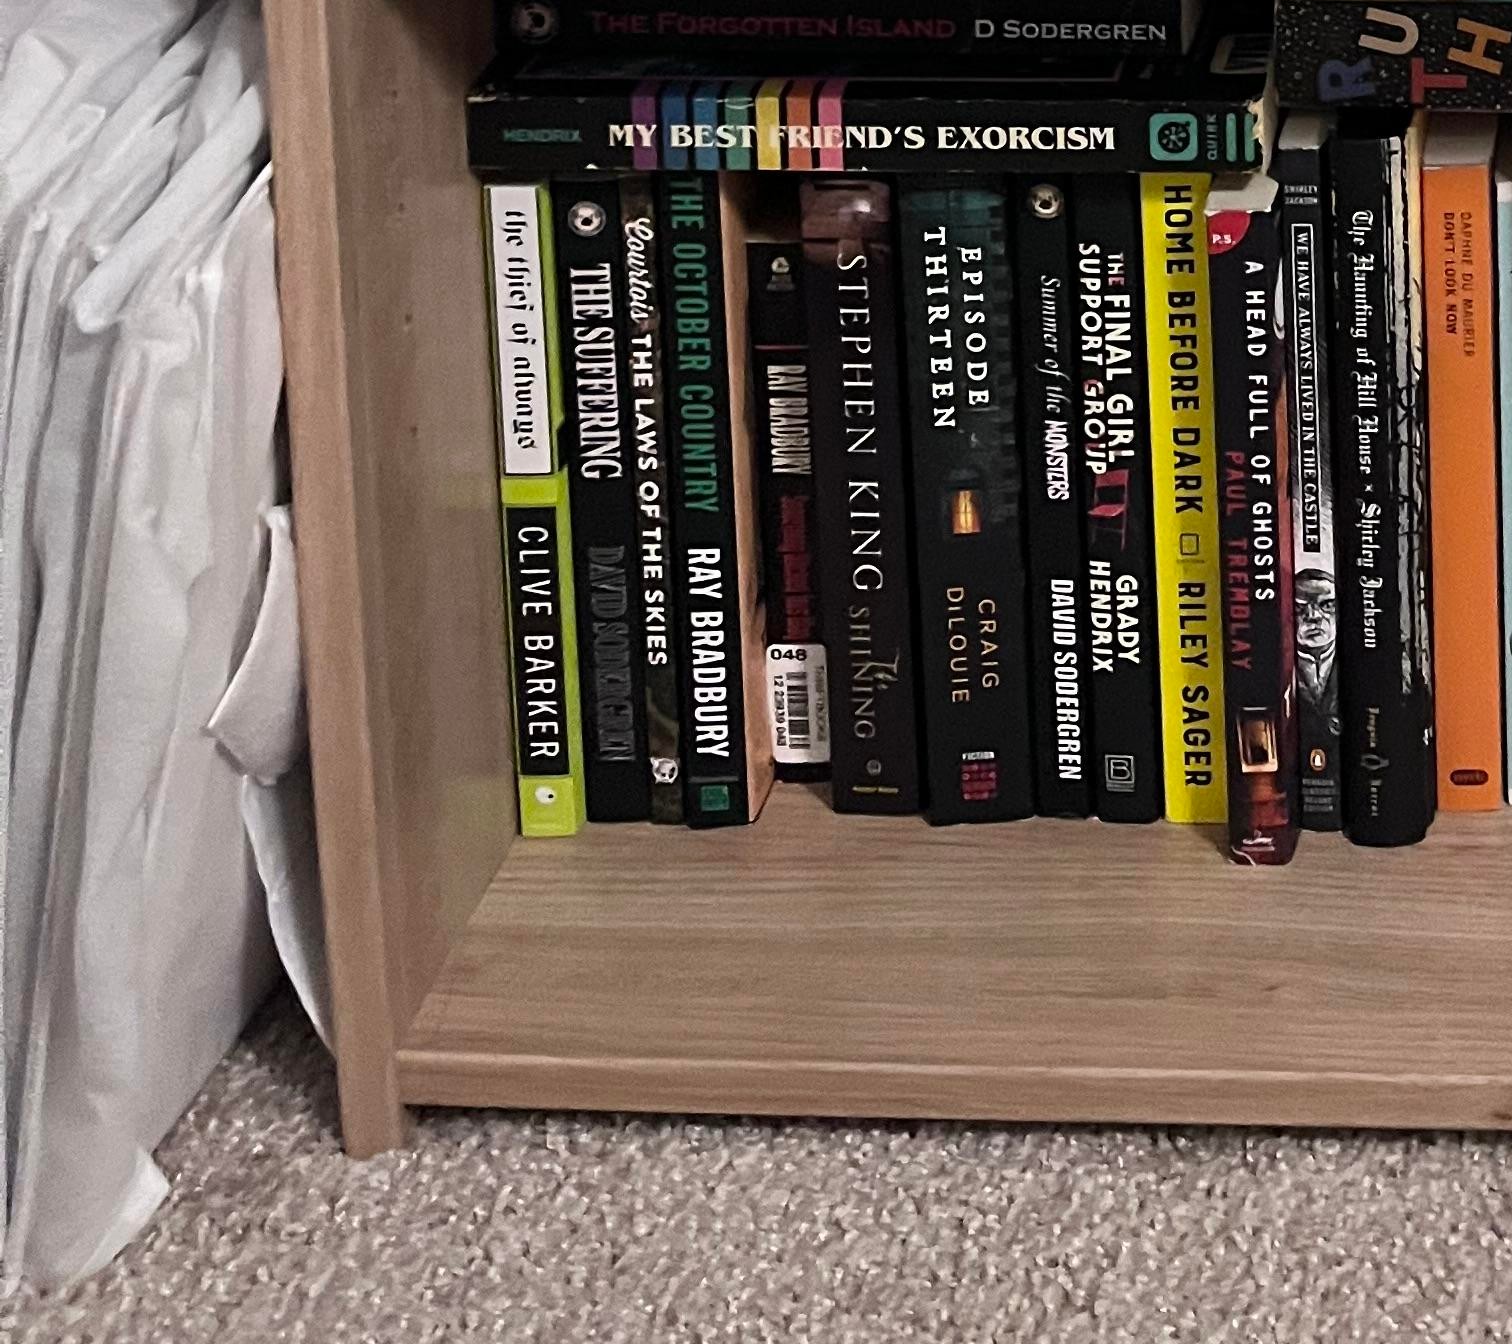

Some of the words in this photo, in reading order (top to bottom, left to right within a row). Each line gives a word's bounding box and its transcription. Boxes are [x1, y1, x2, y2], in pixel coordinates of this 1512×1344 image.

[608, 124, 657, 148] MY
[670, 124, 753, 149] BEST
[770, 124, 925, 149] FRIEND'S
[937, 126, 1115, 151] EXORCISM
[1164, 185, 1195, 275] HOME
[838, 253, 876, 454] STEPHEN
[924, 227, 955, 428] THIRTEEN
[960, 247, 989, 406] EPISODE
[1168, 291, 1200, 412] BEFORE
[572, 326, 623, 480] SUFFERING
[1172, 428, 1203, 513] DARK
[518, 526, 553, 616] CLIVE
[688, 548, 722, 599] RAY
[848, 481, 883, 591] KING
[1178, 582, 1208, 668] RILEY
[524, 634, 560, 758] BARKER
[690, 612, 729, 757] BRADBURY
[1182, 686, 1211, 786] SAGER
